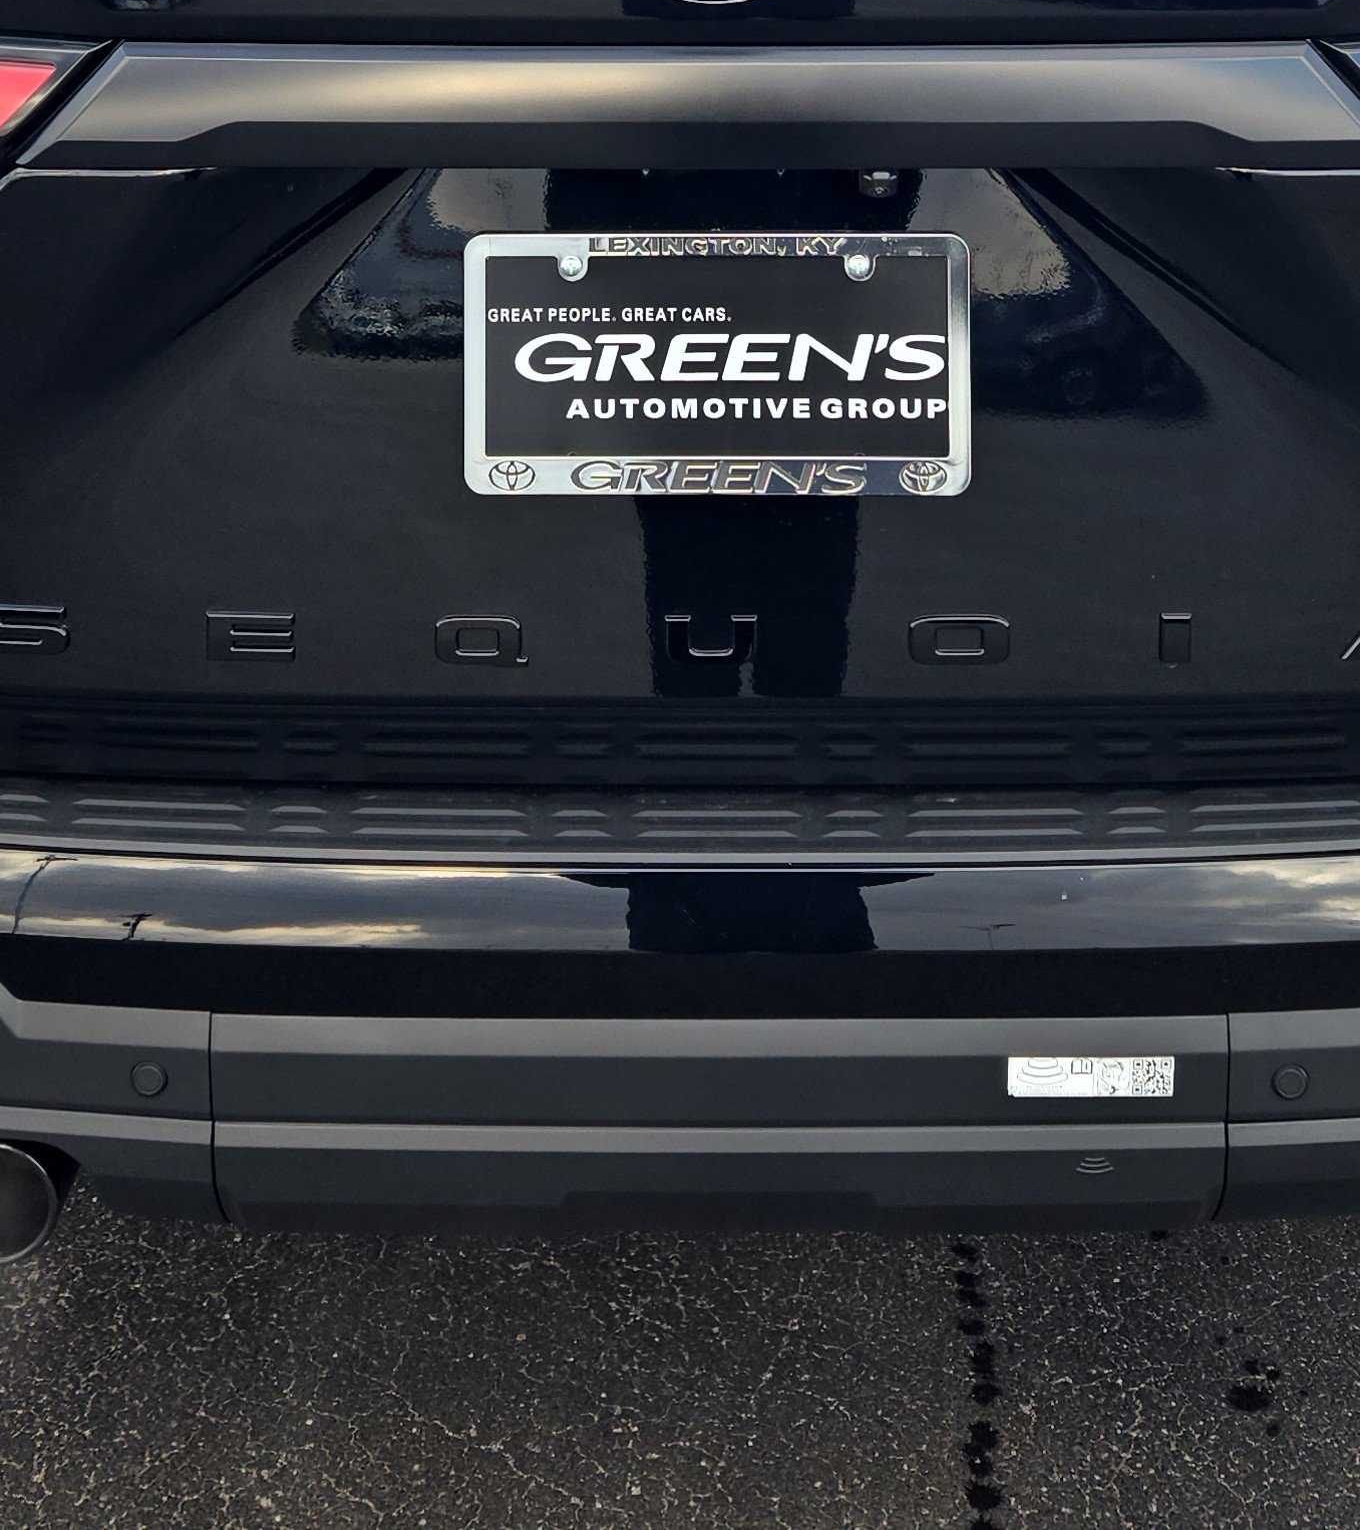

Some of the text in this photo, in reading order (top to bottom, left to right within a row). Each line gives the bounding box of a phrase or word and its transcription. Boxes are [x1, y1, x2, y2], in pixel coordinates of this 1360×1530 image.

[589, 237, 846, 256] LEXINGTON, KY
[487, 307, 732, 322] GREAT PEOPLE. GREAT CARS.
[514, 332, 946, 382] GREEN'S
[566, 397, 948, 419] AUTOMOTIVE GROUP
[570, 460, 868, 495] GREEN'S
